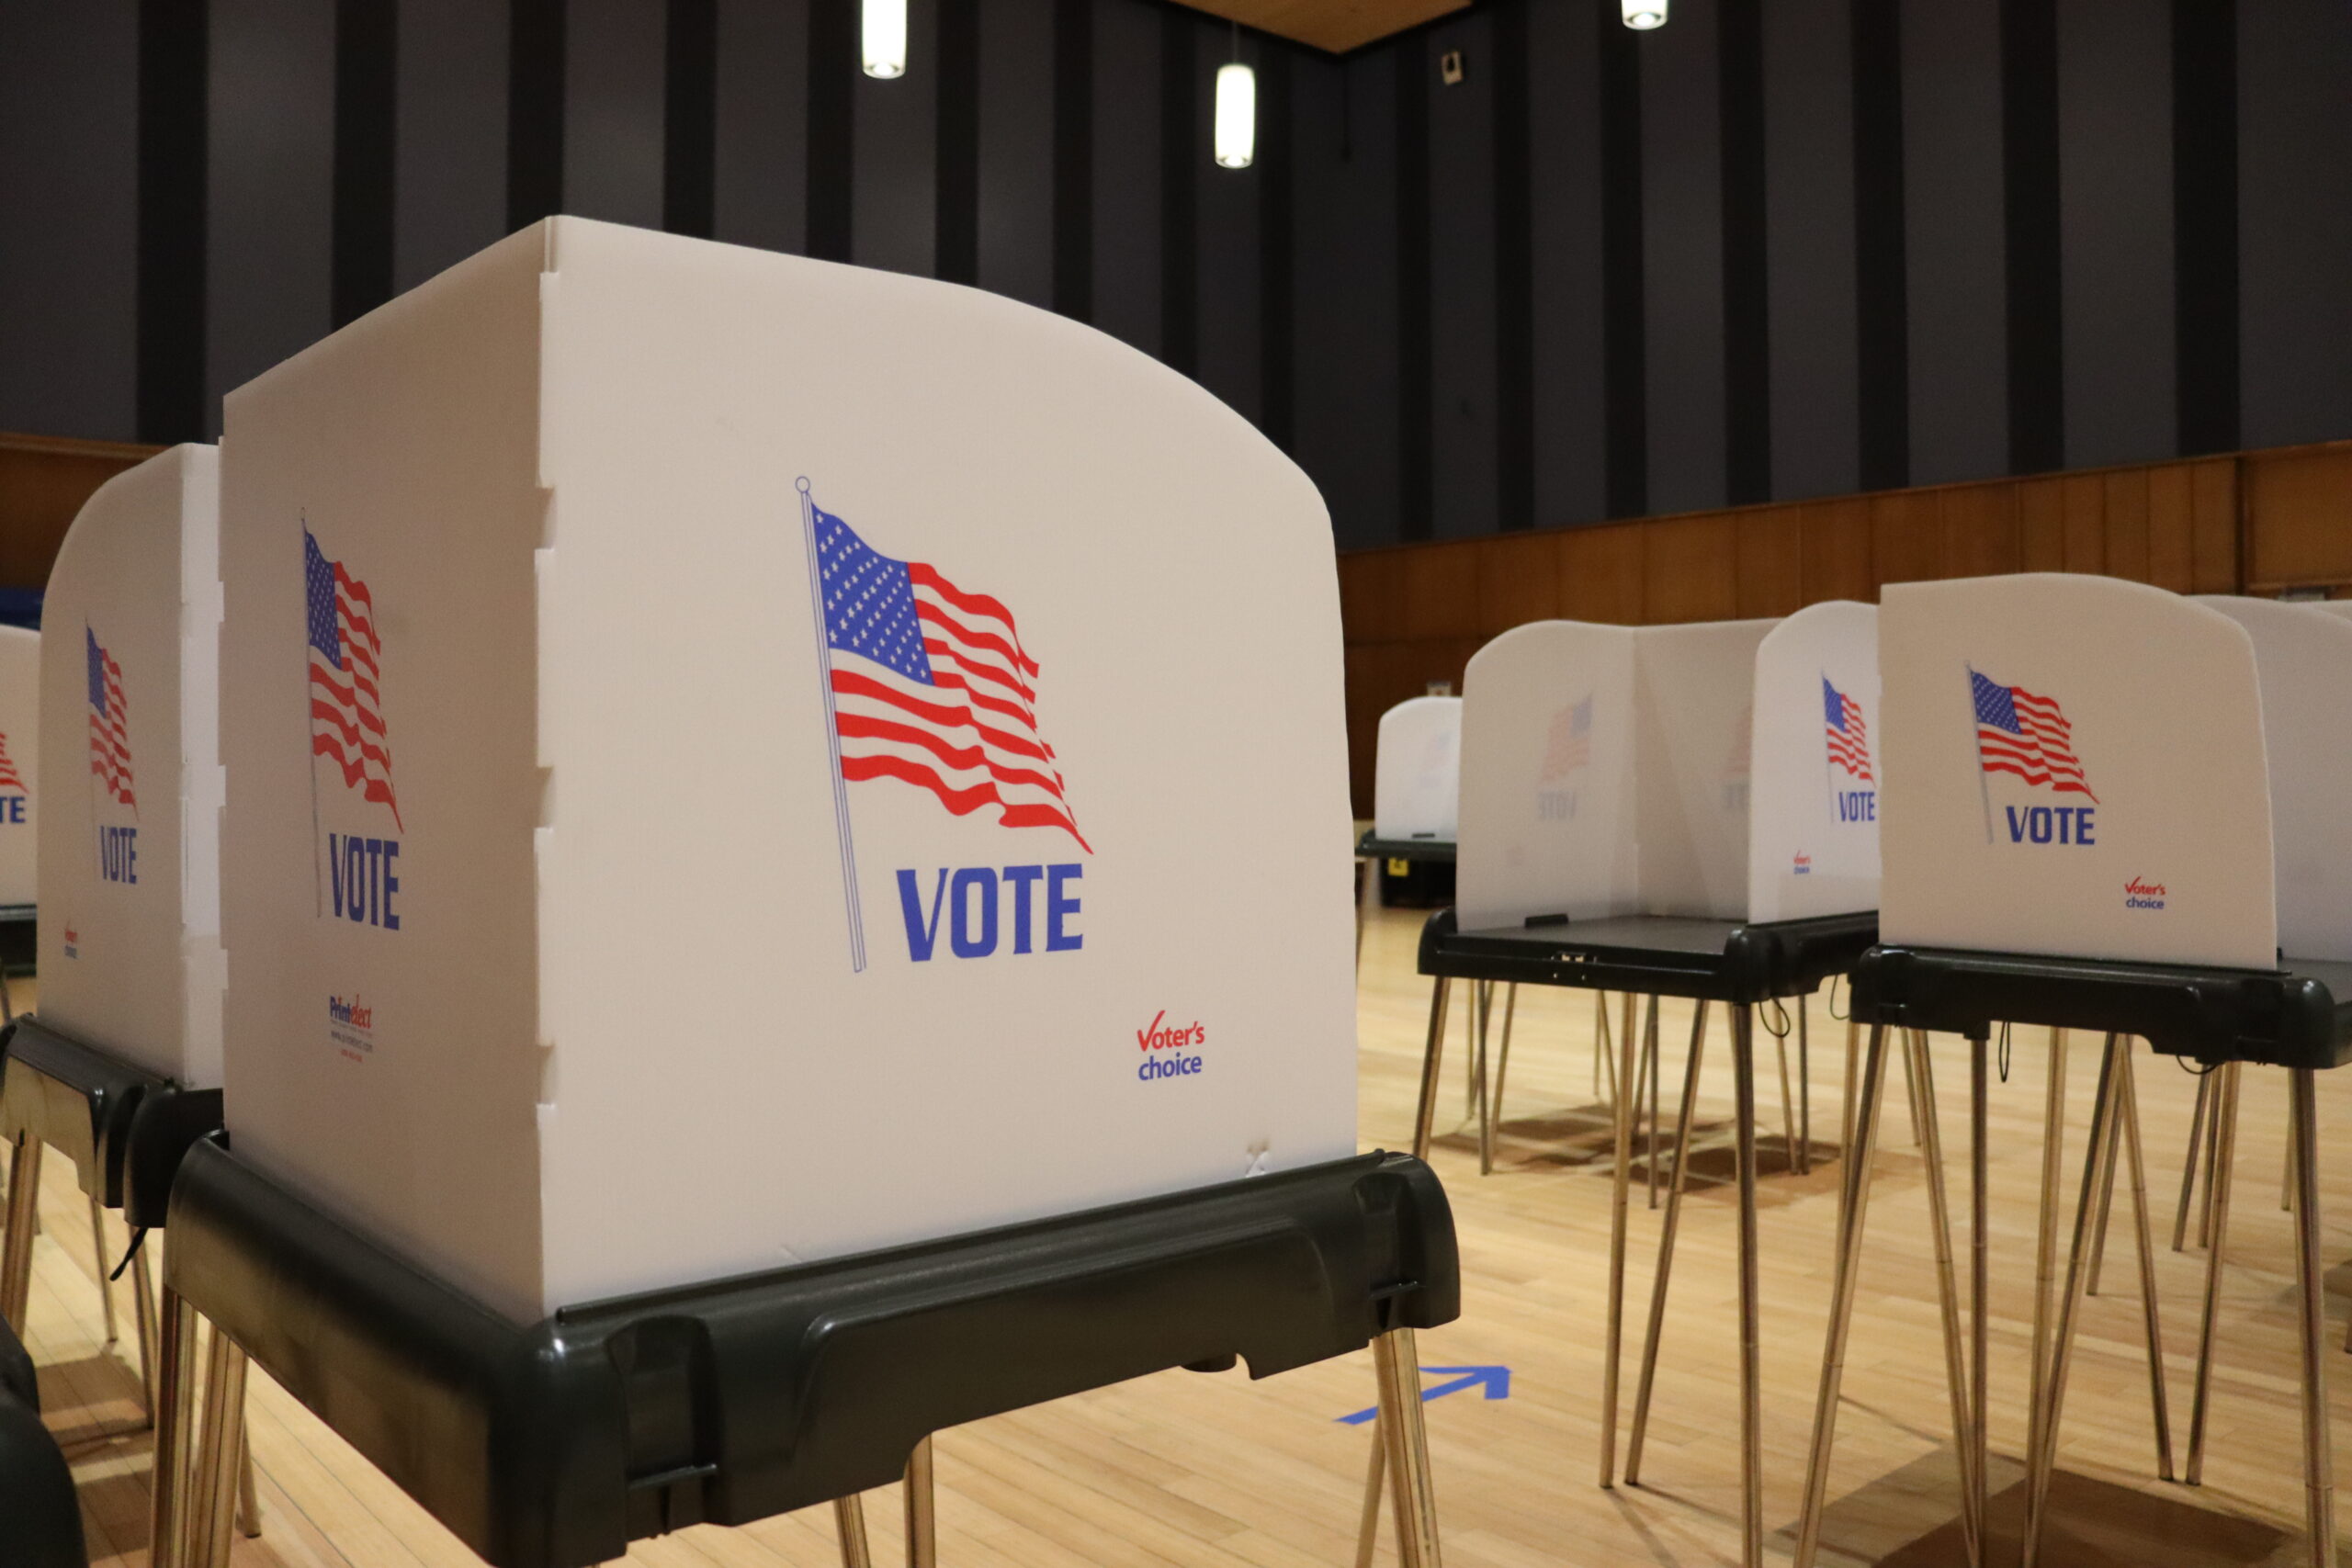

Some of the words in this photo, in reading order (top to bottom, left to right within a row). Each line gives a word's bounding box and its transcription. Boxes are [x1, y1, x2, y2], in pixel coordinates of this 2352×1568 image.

[1838, 791, 1875, 822] VOTE
[2006, 806, 2095, 845] VOTE
[100, 825, 137, 885] VOTE
[330, 832, 400, 931] VOTE
[2125, 876, 2165, 896] Voter's
[896, 863, 1083, 962] VOTE
[2126, 897, 2165, 909] choice
[1137, 1010, 1205, 1052] Voter's
[1138, 1052, 1203, 1080] choice
